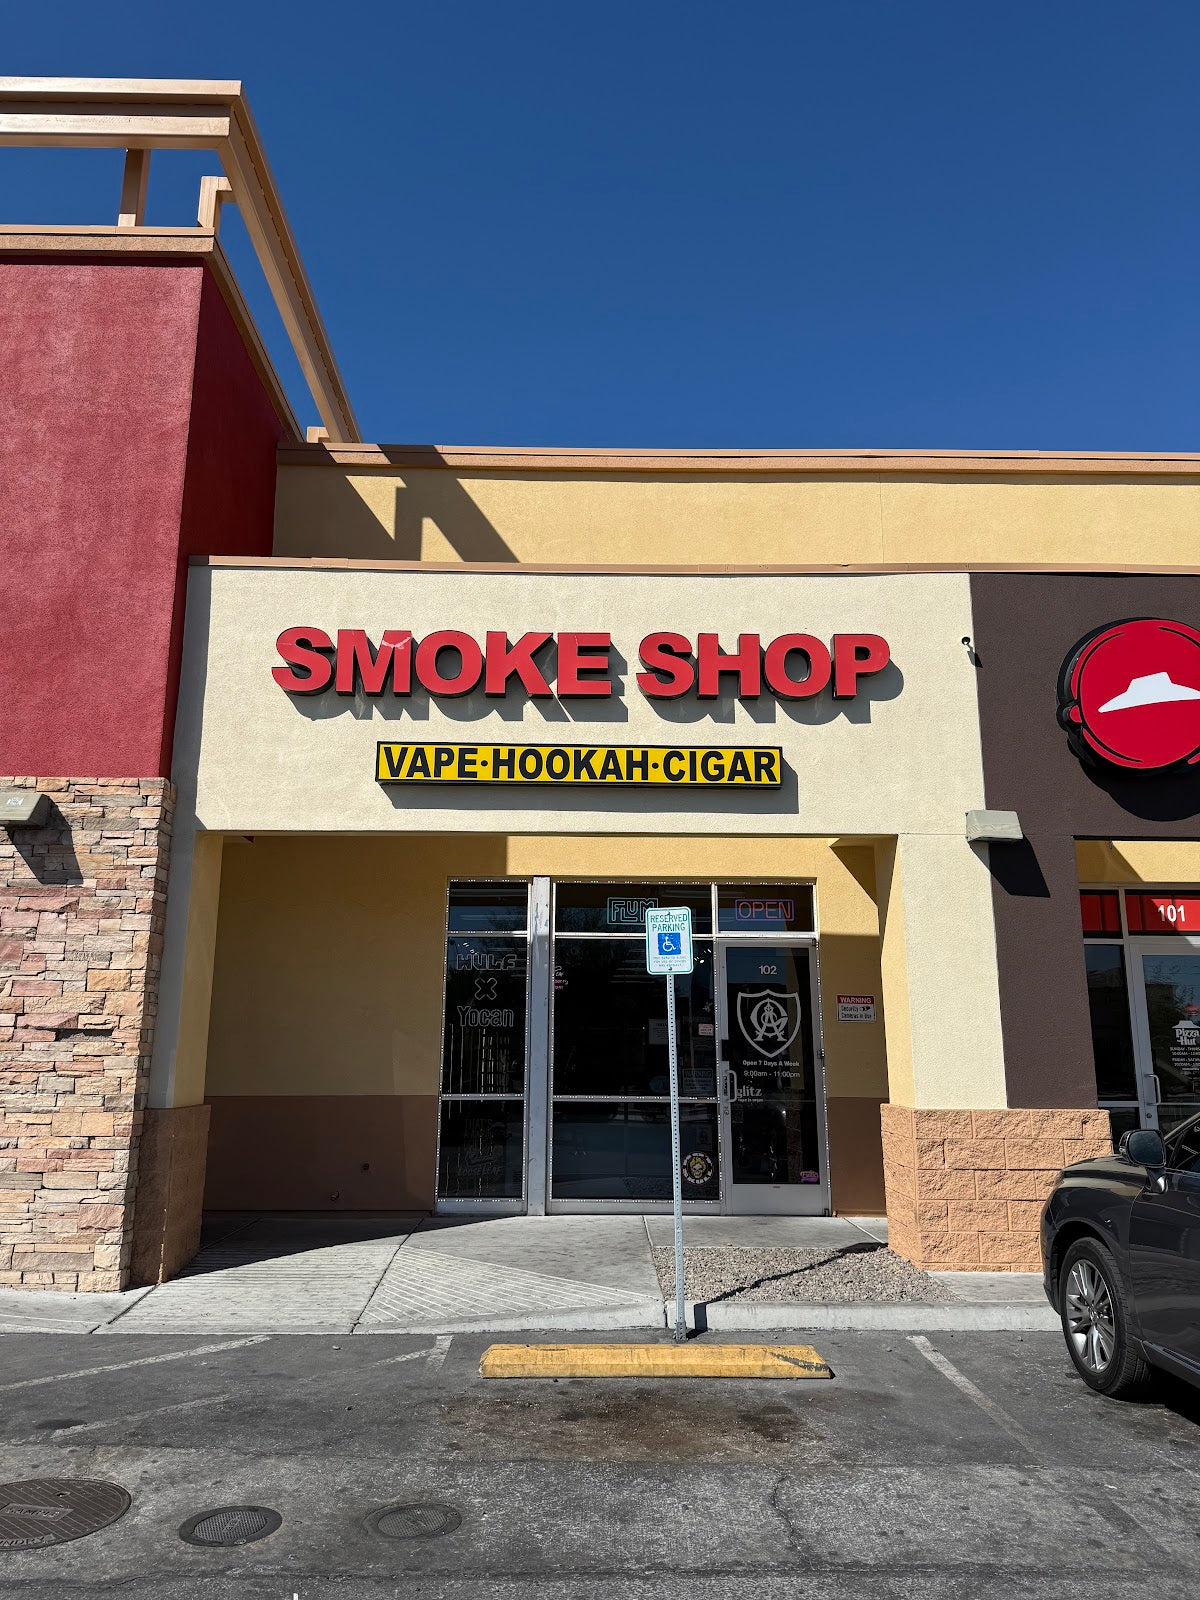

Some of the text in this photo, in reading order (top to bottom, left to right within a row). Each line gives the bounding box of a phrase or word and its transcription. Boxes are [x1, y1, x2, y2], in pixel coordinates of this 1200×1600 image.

[271, 625, 892, 699] SMOKE SHOP
[738, 901, 791, 919] OPEN
[1158, 904, 1186, 922] 101
[650, 913, 688, 923] RESERVED
[652, 922, 686, 932] PARKING
[759, 965, 778, 975] 102
[839, 996, 872, 1004] WARNING
[456, 1005, 515, 1028] Yocan
[1175, 1028, 1200, 1038] Pizza
[1176, 1037, 1197, 1046] Hut
[742, 1059, 758, 1067] Open
[736, 1084, 763, 1099] glitz
